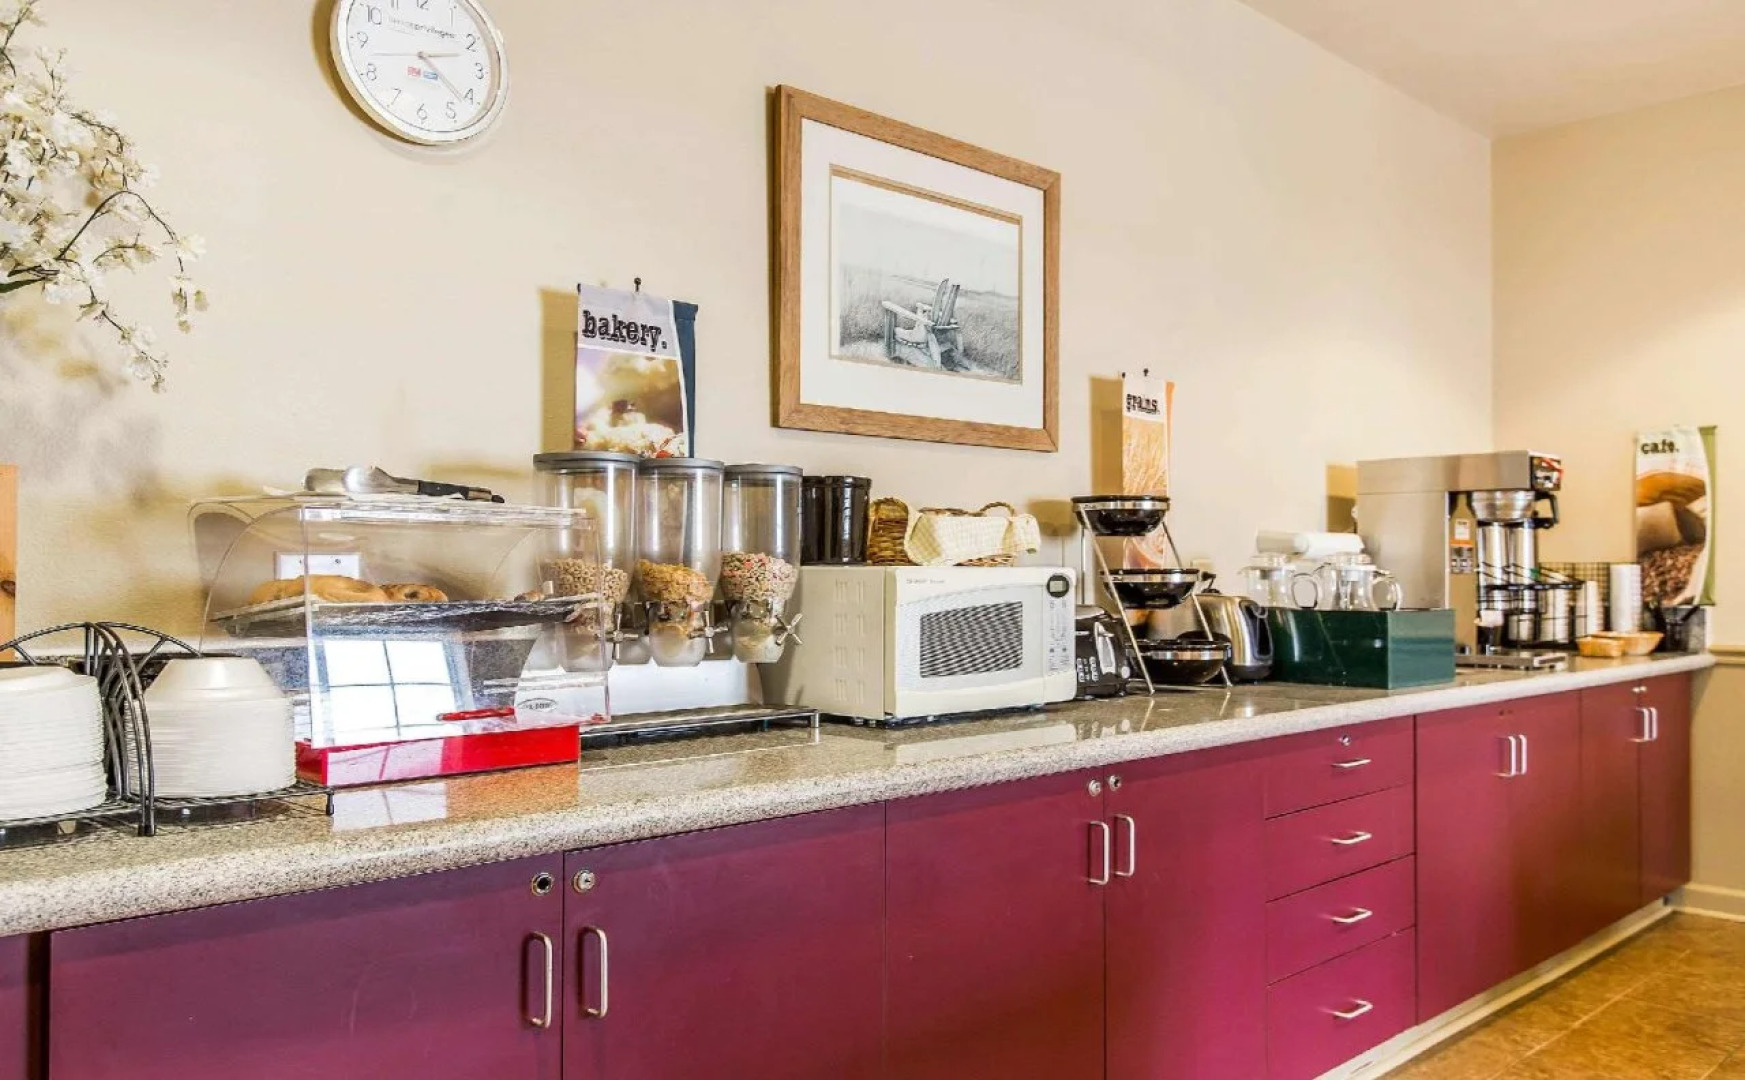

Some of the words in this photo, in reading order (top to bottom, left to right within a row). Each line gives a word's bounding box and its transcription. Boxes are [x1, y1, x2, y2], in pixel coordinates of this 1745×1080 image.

[416, 0, 429, 11] 12
[366, 5, 382, 26] 10
[356, 31, 369, 49] 9
[465, 33, 477, 52] 2
[366, 62, 377, 81] 8
[475, 62, 485, 80] 3
[393, 88, 402, 106] 7
[464, 88, 474, 105] 4
[416, 103, 428, 121] 6
[445, 101, 457, 120] 5
[582, 310, 668, 352] bakery.
